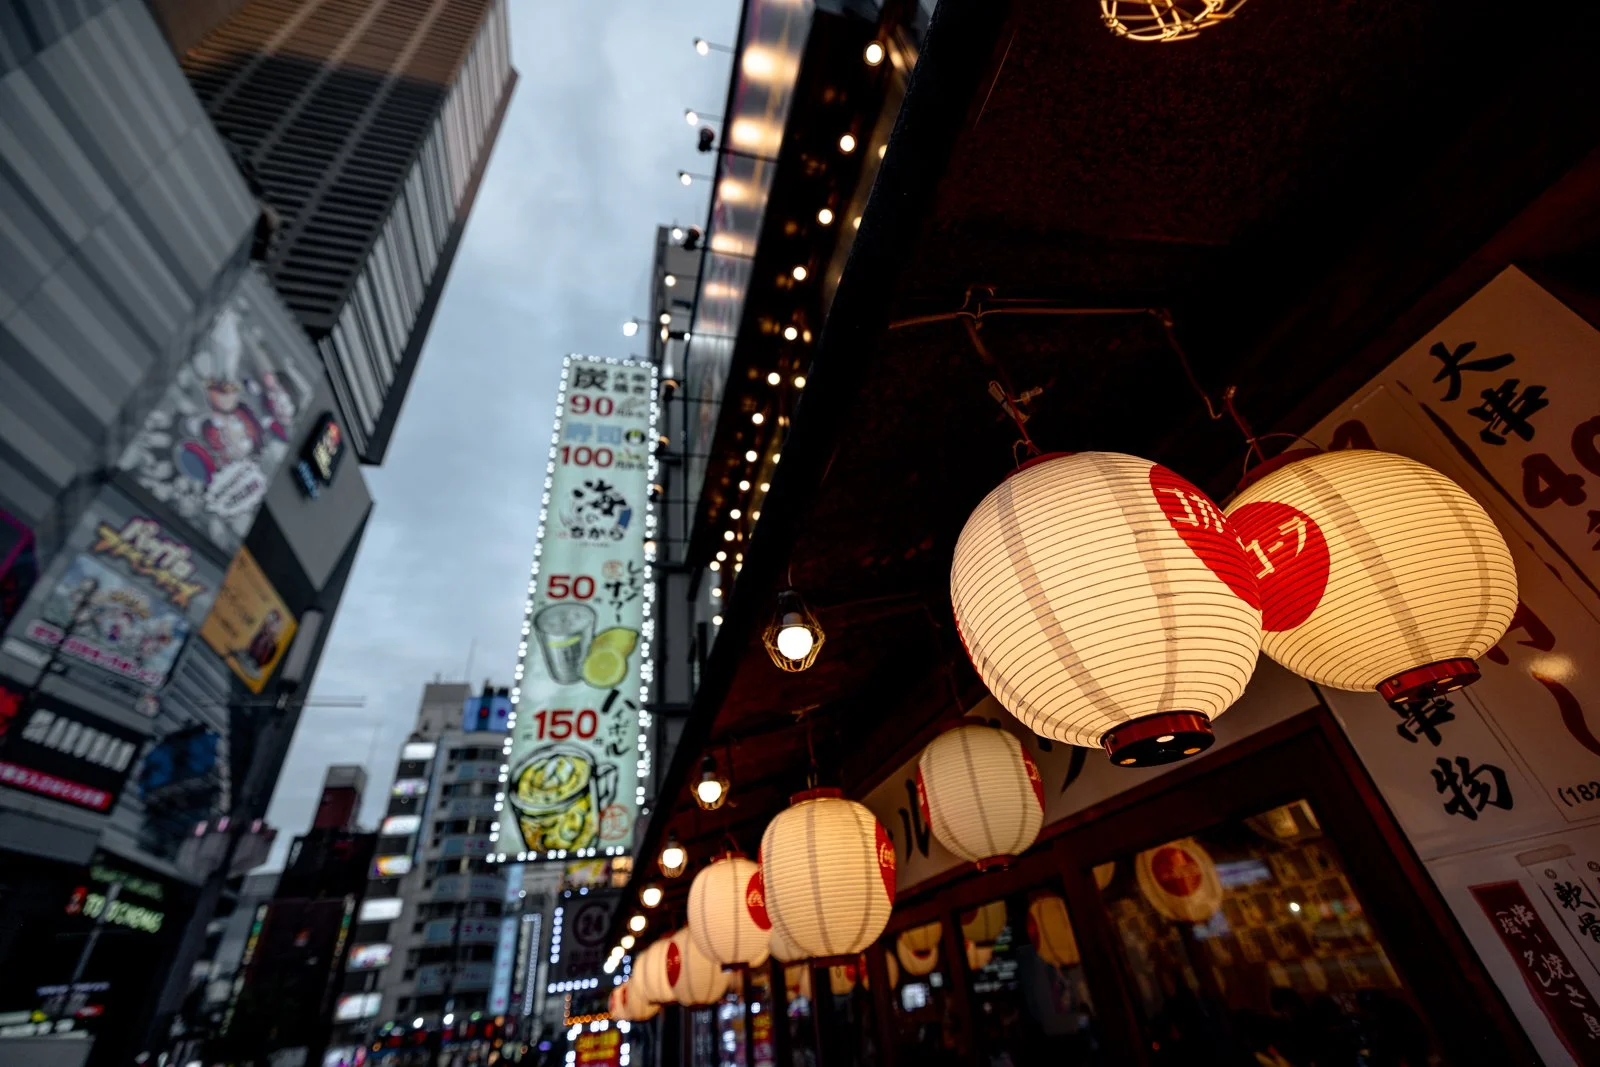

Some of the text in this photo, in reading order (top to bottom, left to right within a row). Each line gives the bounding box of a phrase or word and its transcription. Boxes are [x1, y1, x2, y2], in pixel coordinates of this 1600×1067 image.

[569, 394, 613, 417] 90
[561, 446, 613, 468] 100
[545, 575, 596, 600] 50
[533, 709, 598, 740] 150
[602, 688, 637, 757] ハイボール
